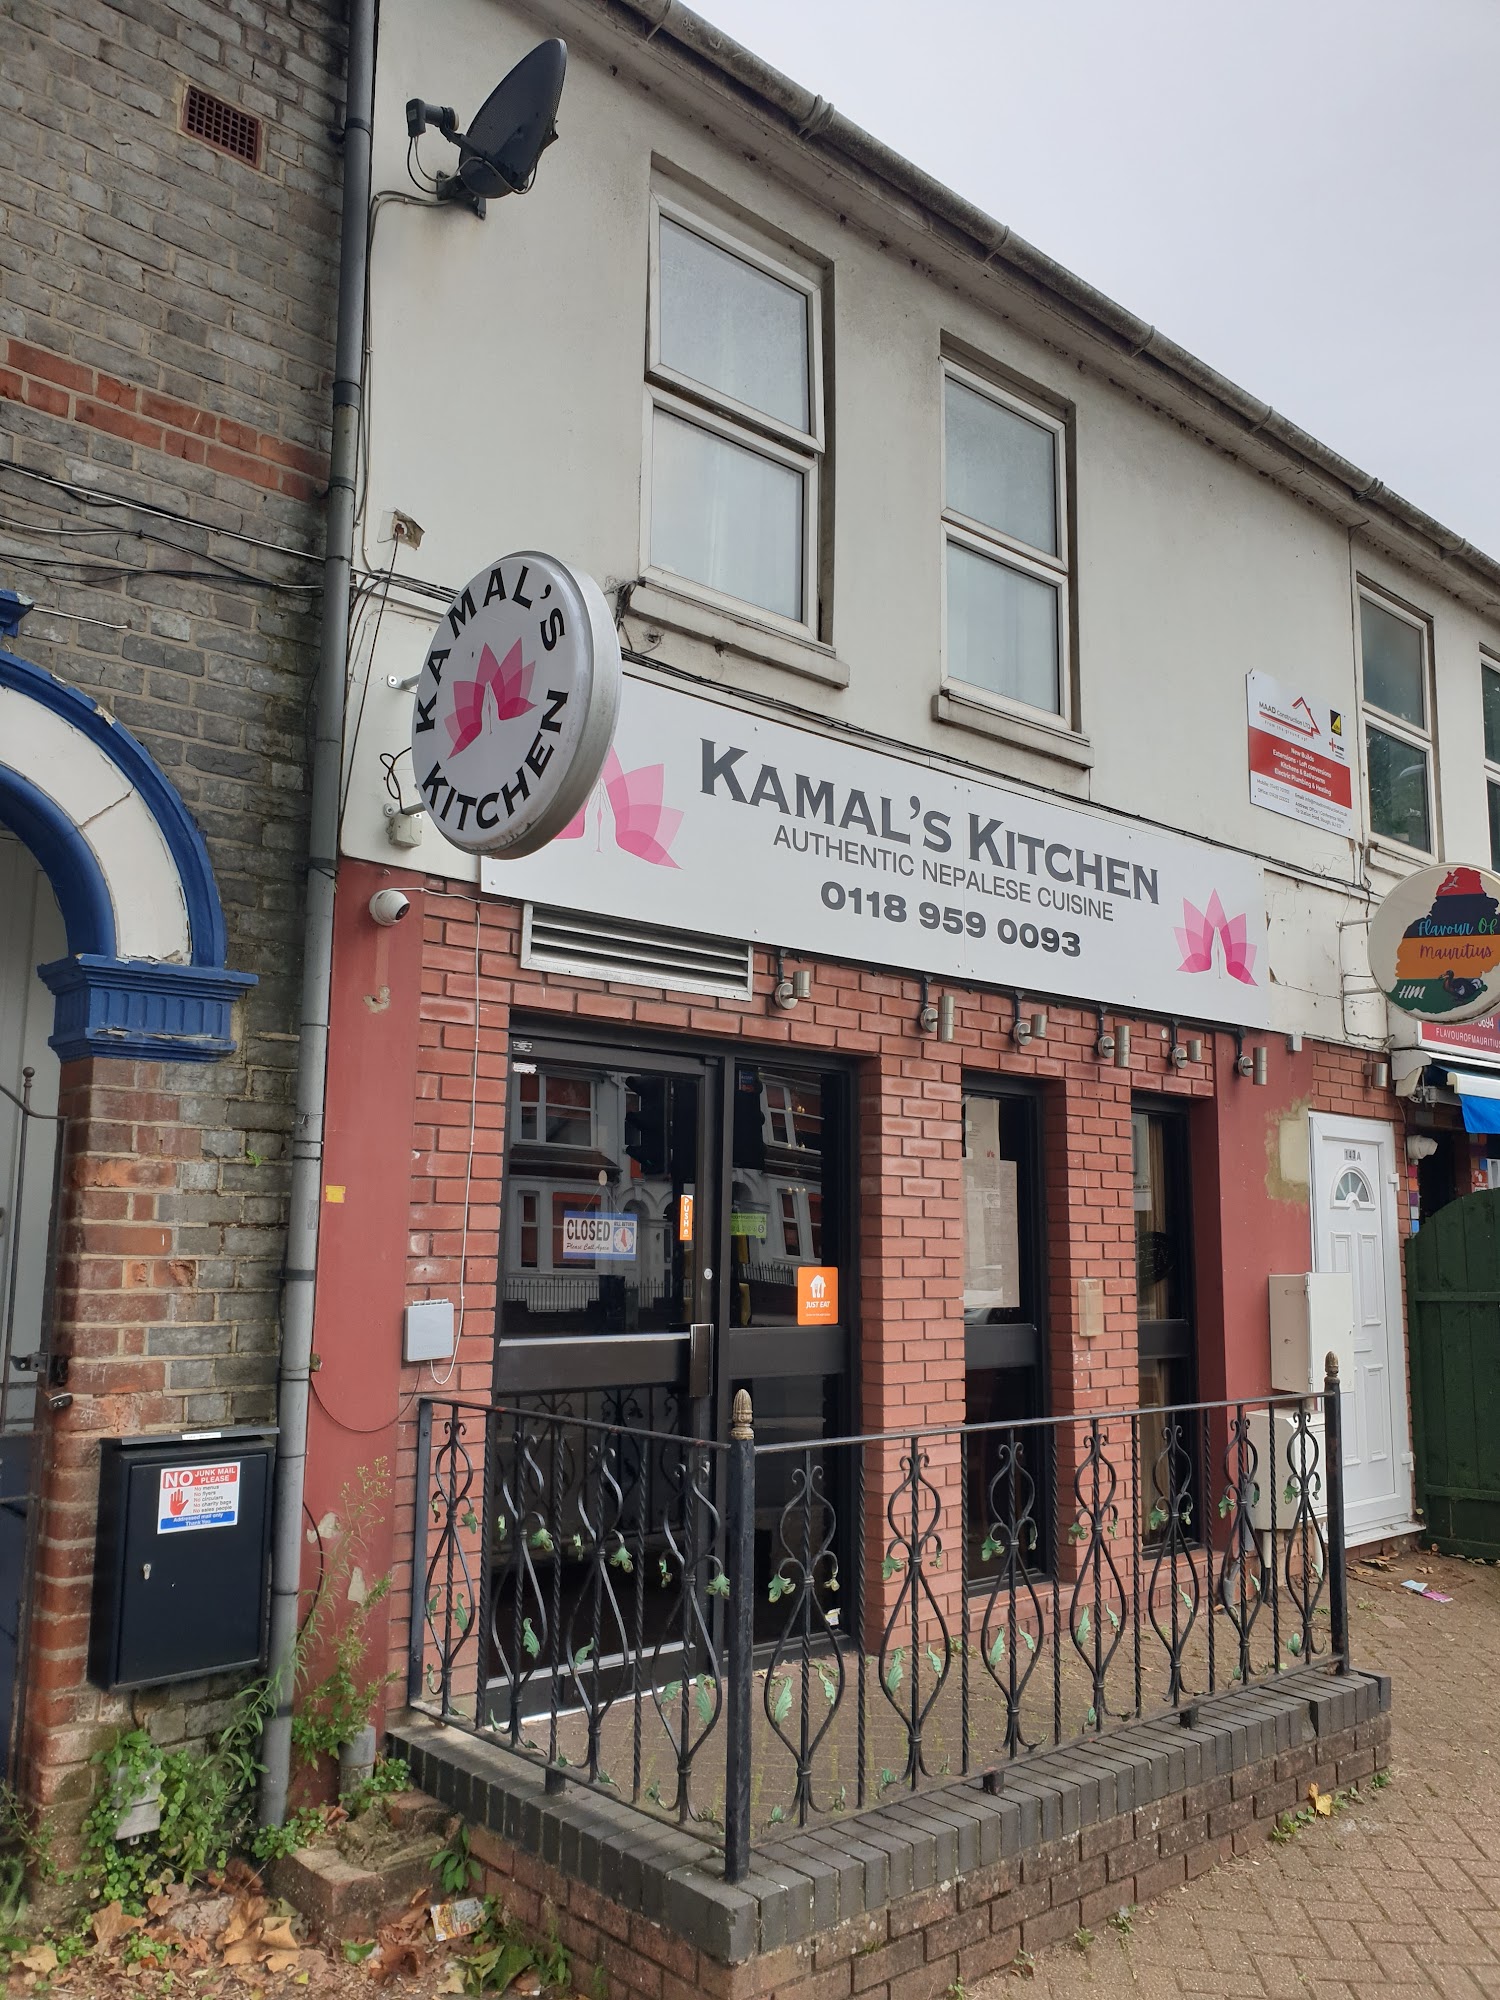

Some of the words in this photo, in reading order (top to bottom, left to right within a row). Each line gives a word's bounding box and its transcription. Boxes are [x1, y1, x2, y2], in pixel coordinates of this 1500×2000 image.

[415, 565, 567, 734] KAMAL'S
[1258, 701, 1276, 714] MAAD
[1276, 709, 1303, 726] Construction
[421, 689, 569, 831] KITCHEN
[1272, 749, 1297, 764] Extensions
[1299, 760, 1308, 769] Loft
[1308, 764, 1332, 778] conversions
[1290, 748, 1301, 756] New
[1301, 752, 1315, 762] Builds
[1274, 767, 1291, 779] Electric
[1291, 774, 1312, 788] Plumbing
[1316, 783, 1332, 797] Heating
[1280, 761, 1299, 774] Kitchens
[1303, 770, 1326, 785] Bathrooms
[699, 738, 952, 854] KAMAL'S
[967, 812, 1160, 905] KITCHEN
[773, 825, 916, 877] AUTHENTIC
[922, 859, 1032, 902] NEPALESE
[1037, 886, 1115, 922] CUISINE
[820, 881, 908, 924] 0118
[918, 902, 987, 939] 959
[997, 917, 1082, 958] 0093
[1417, 918, 1474, 936] Flavour
[1478, 917, 1498, 935] Of
[1419, 943, 1493, 960] Mauritius
[566, 1219, 611, 1241] CLOSED
[566, 1242, 583, 1250] Please
[583, 1243, 595, 1251] Call
[594, 1243, 610, 1251] Again
[806, 1301, 820, 1309] JUST
[165, 1470, 194, 1488] NO
[200, 1475, 230, 1484] PLEASE
[217, 1467, 236, 1475] MAIL
[173, 1514, 201, 1523] Addressed
